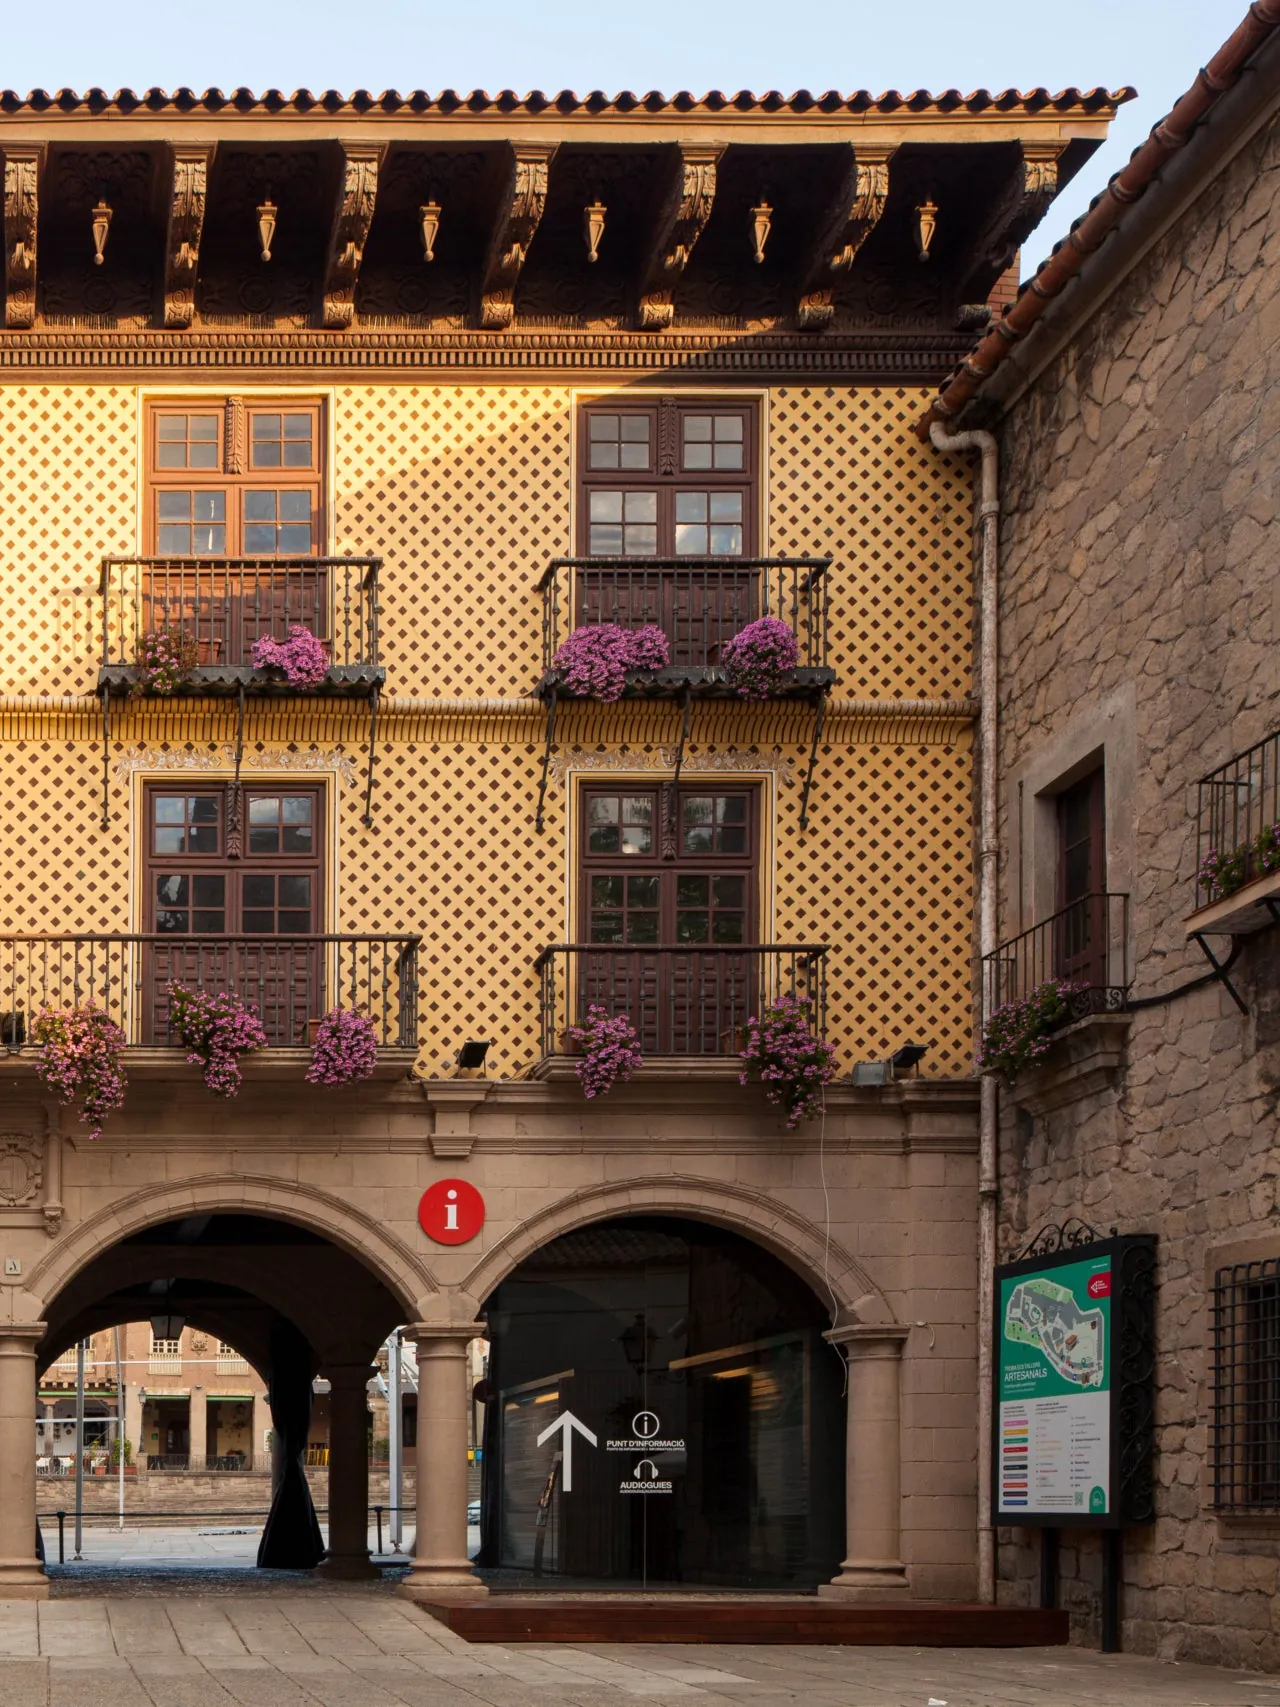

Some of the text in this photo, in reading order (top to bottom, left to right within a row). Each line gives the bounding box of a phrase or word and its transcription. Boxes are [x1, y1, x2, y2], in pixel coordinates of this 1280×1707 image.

[444, 1189, 459, 1229] i
[1004, 1367, 1049, 1383] ARTESANALS
[629, 1439, 685, 1447] D'INFORMACIÓ
